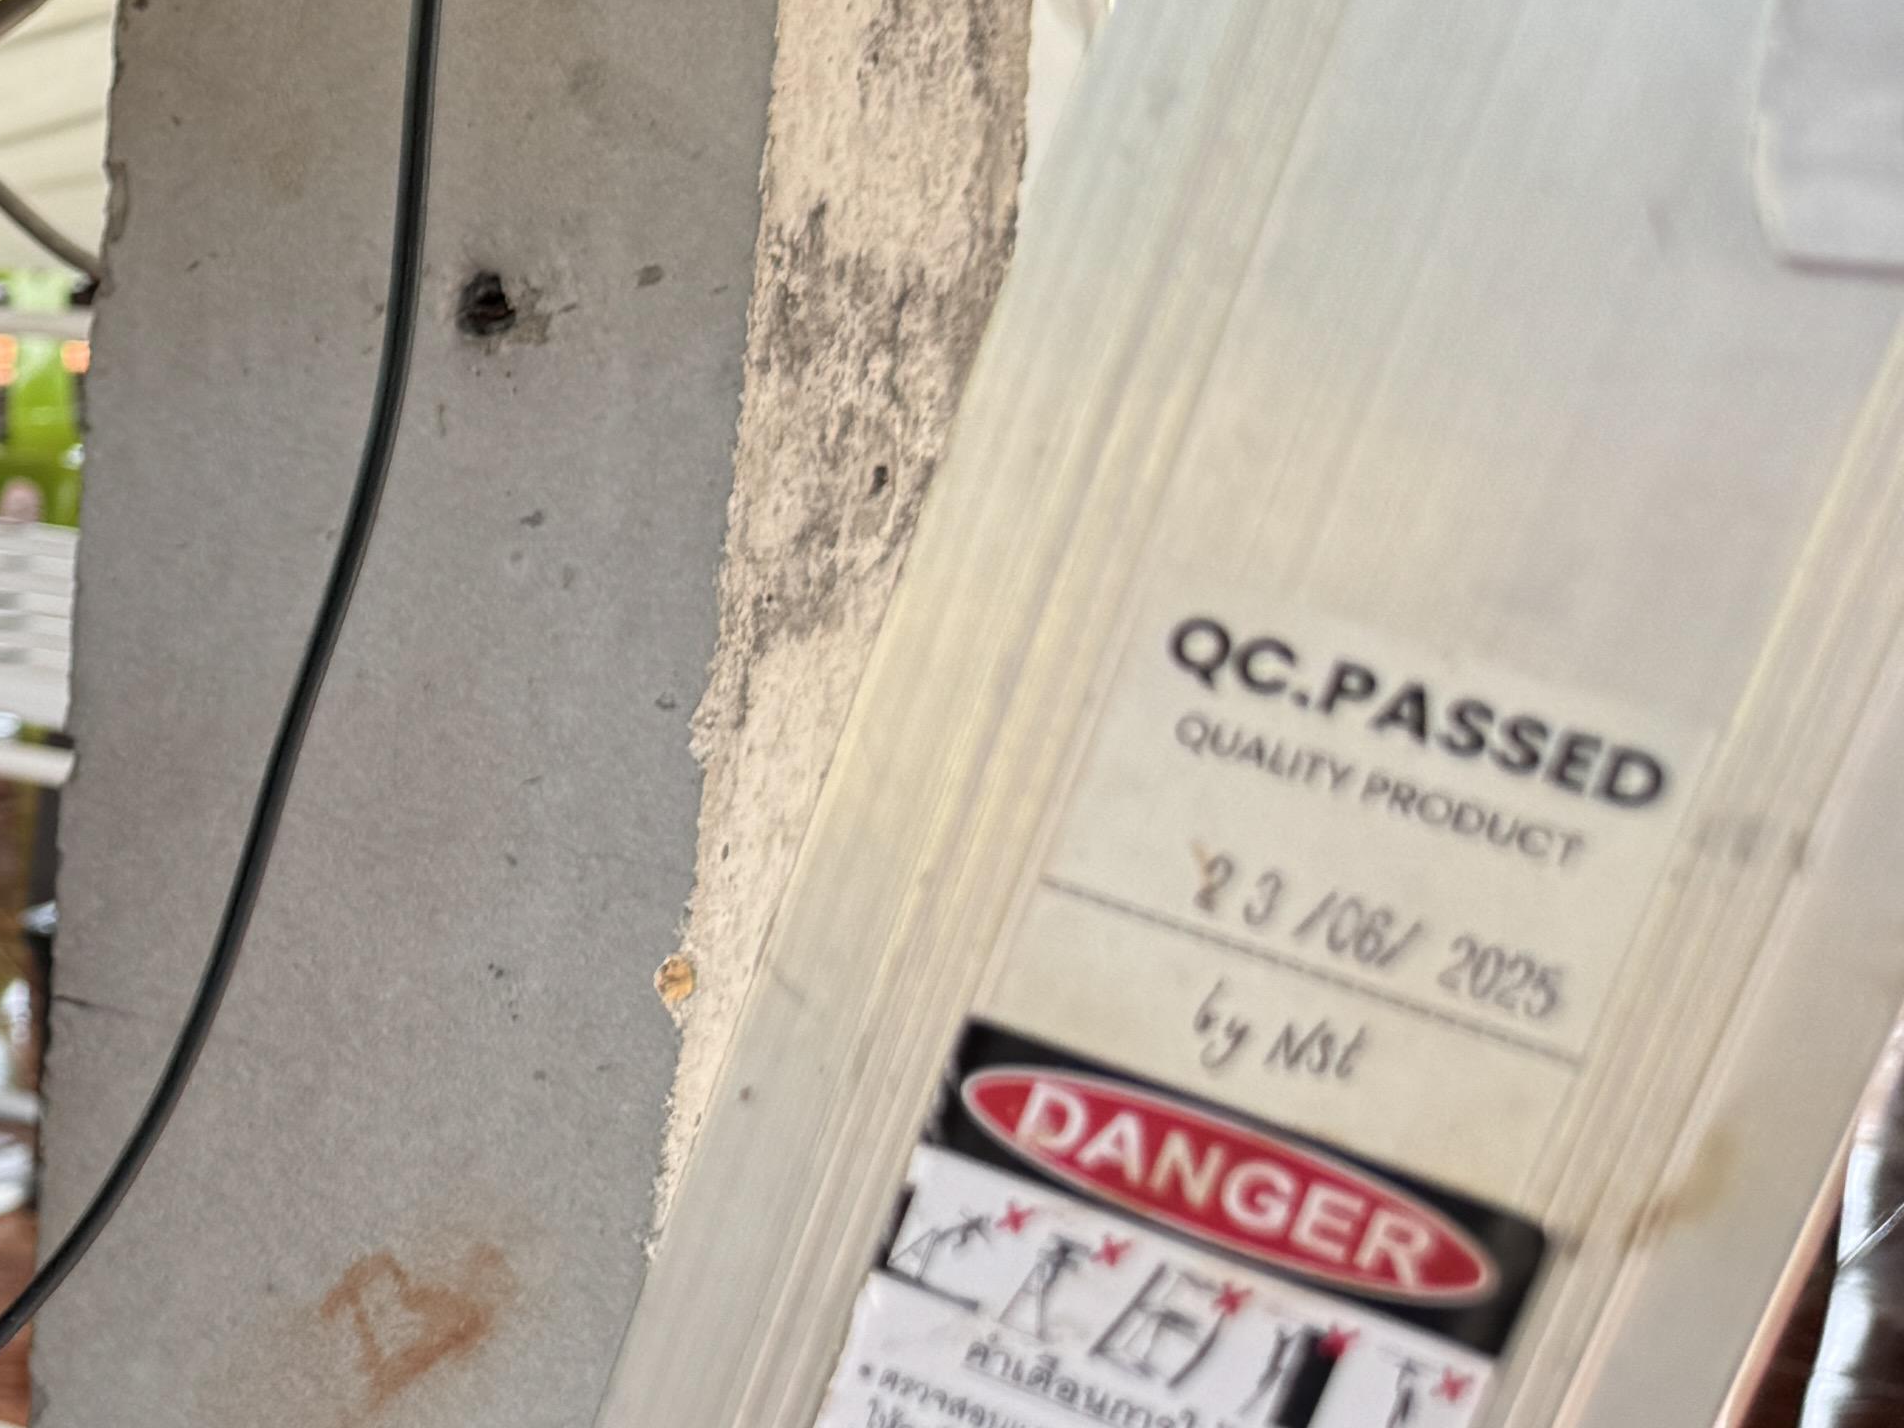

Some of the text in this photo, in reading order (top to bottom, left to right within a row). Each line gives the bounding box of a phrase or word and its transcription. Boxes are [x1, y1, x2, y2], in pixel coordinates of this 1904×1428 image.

[1169, 617, 1666, 808] QC.PASSED
[1175, 712, 1584, 864] QUALITY PRODUCT
[1011, 1077, 1439, 1293] DANGER
